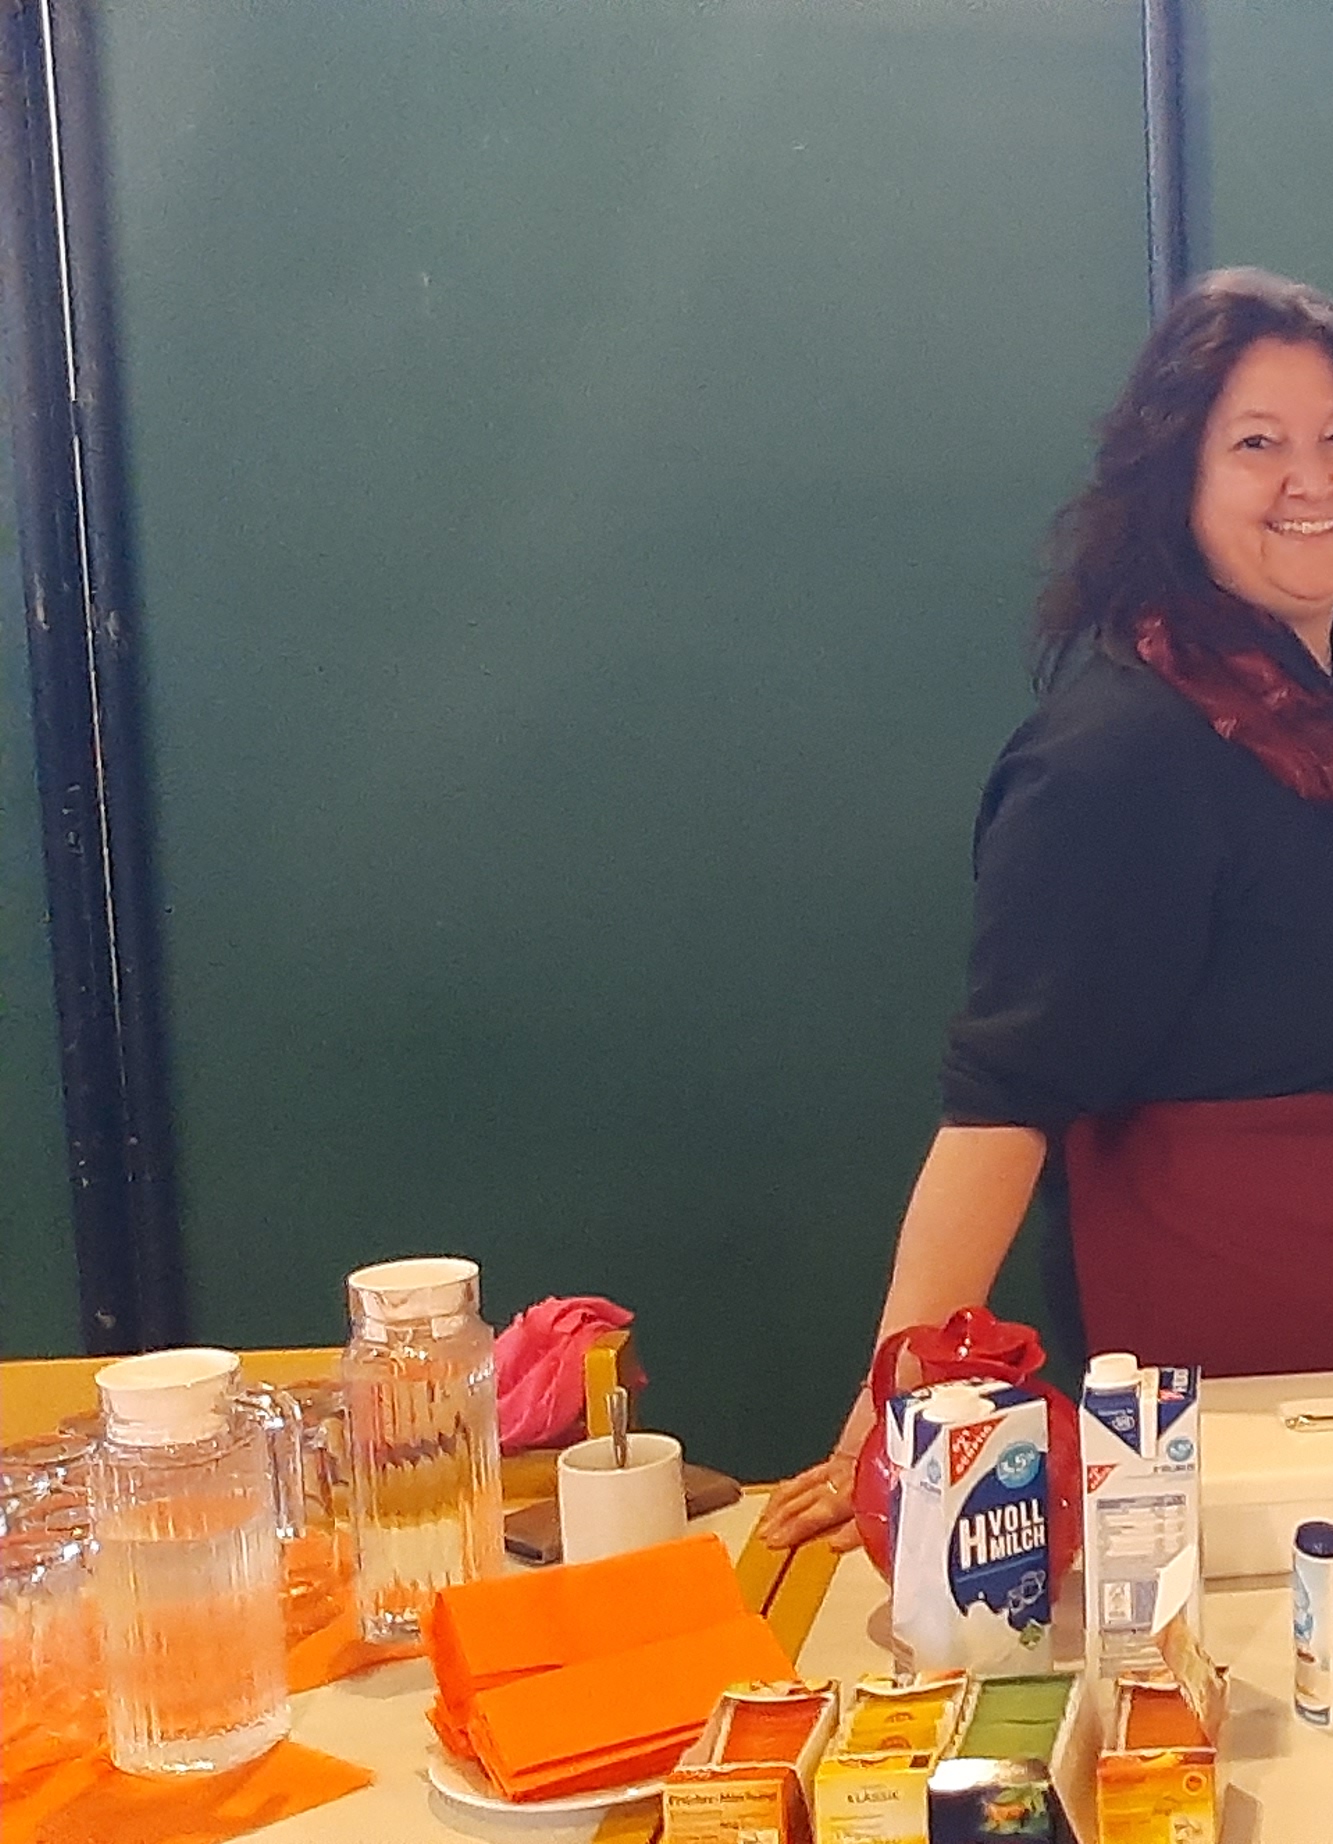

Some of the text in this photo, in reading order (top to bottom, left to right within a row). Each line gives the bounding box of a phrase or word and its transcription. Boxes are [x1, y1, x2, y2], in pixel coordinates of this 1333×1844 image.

[959, 1514, 988, 1570] H
[988, 1498, 1045, 1537] VOLL
[989, 1525, 1047, 1561] MILCH
